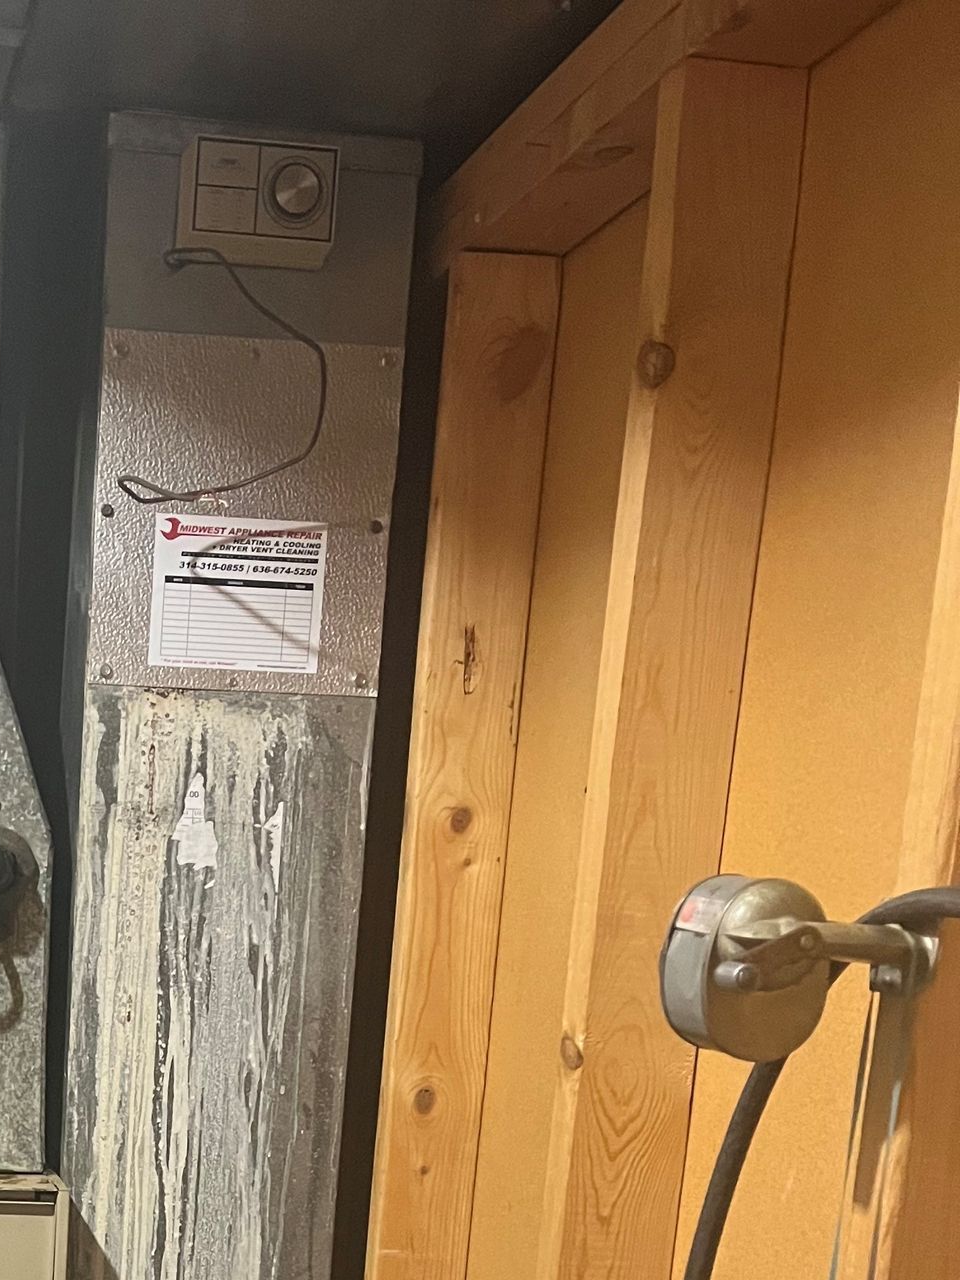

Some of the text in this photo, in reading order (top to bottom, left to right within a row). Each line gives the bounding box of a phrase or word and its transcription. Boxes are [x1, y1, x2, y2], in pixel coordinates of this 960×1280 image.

[180, 524, 323, 540] MIDWEST APPLIANCE REPAIR
[219, 544, 248, 552] DRYER
[275, 548, 319, 556] CLEANING
[233, 538, 271, 547] HEATING
[283, 541, 321, 549] COOLING
[179, 561, 245, 572] 314-315-0855
[253, 565, 318, 576] 636-674-5250
